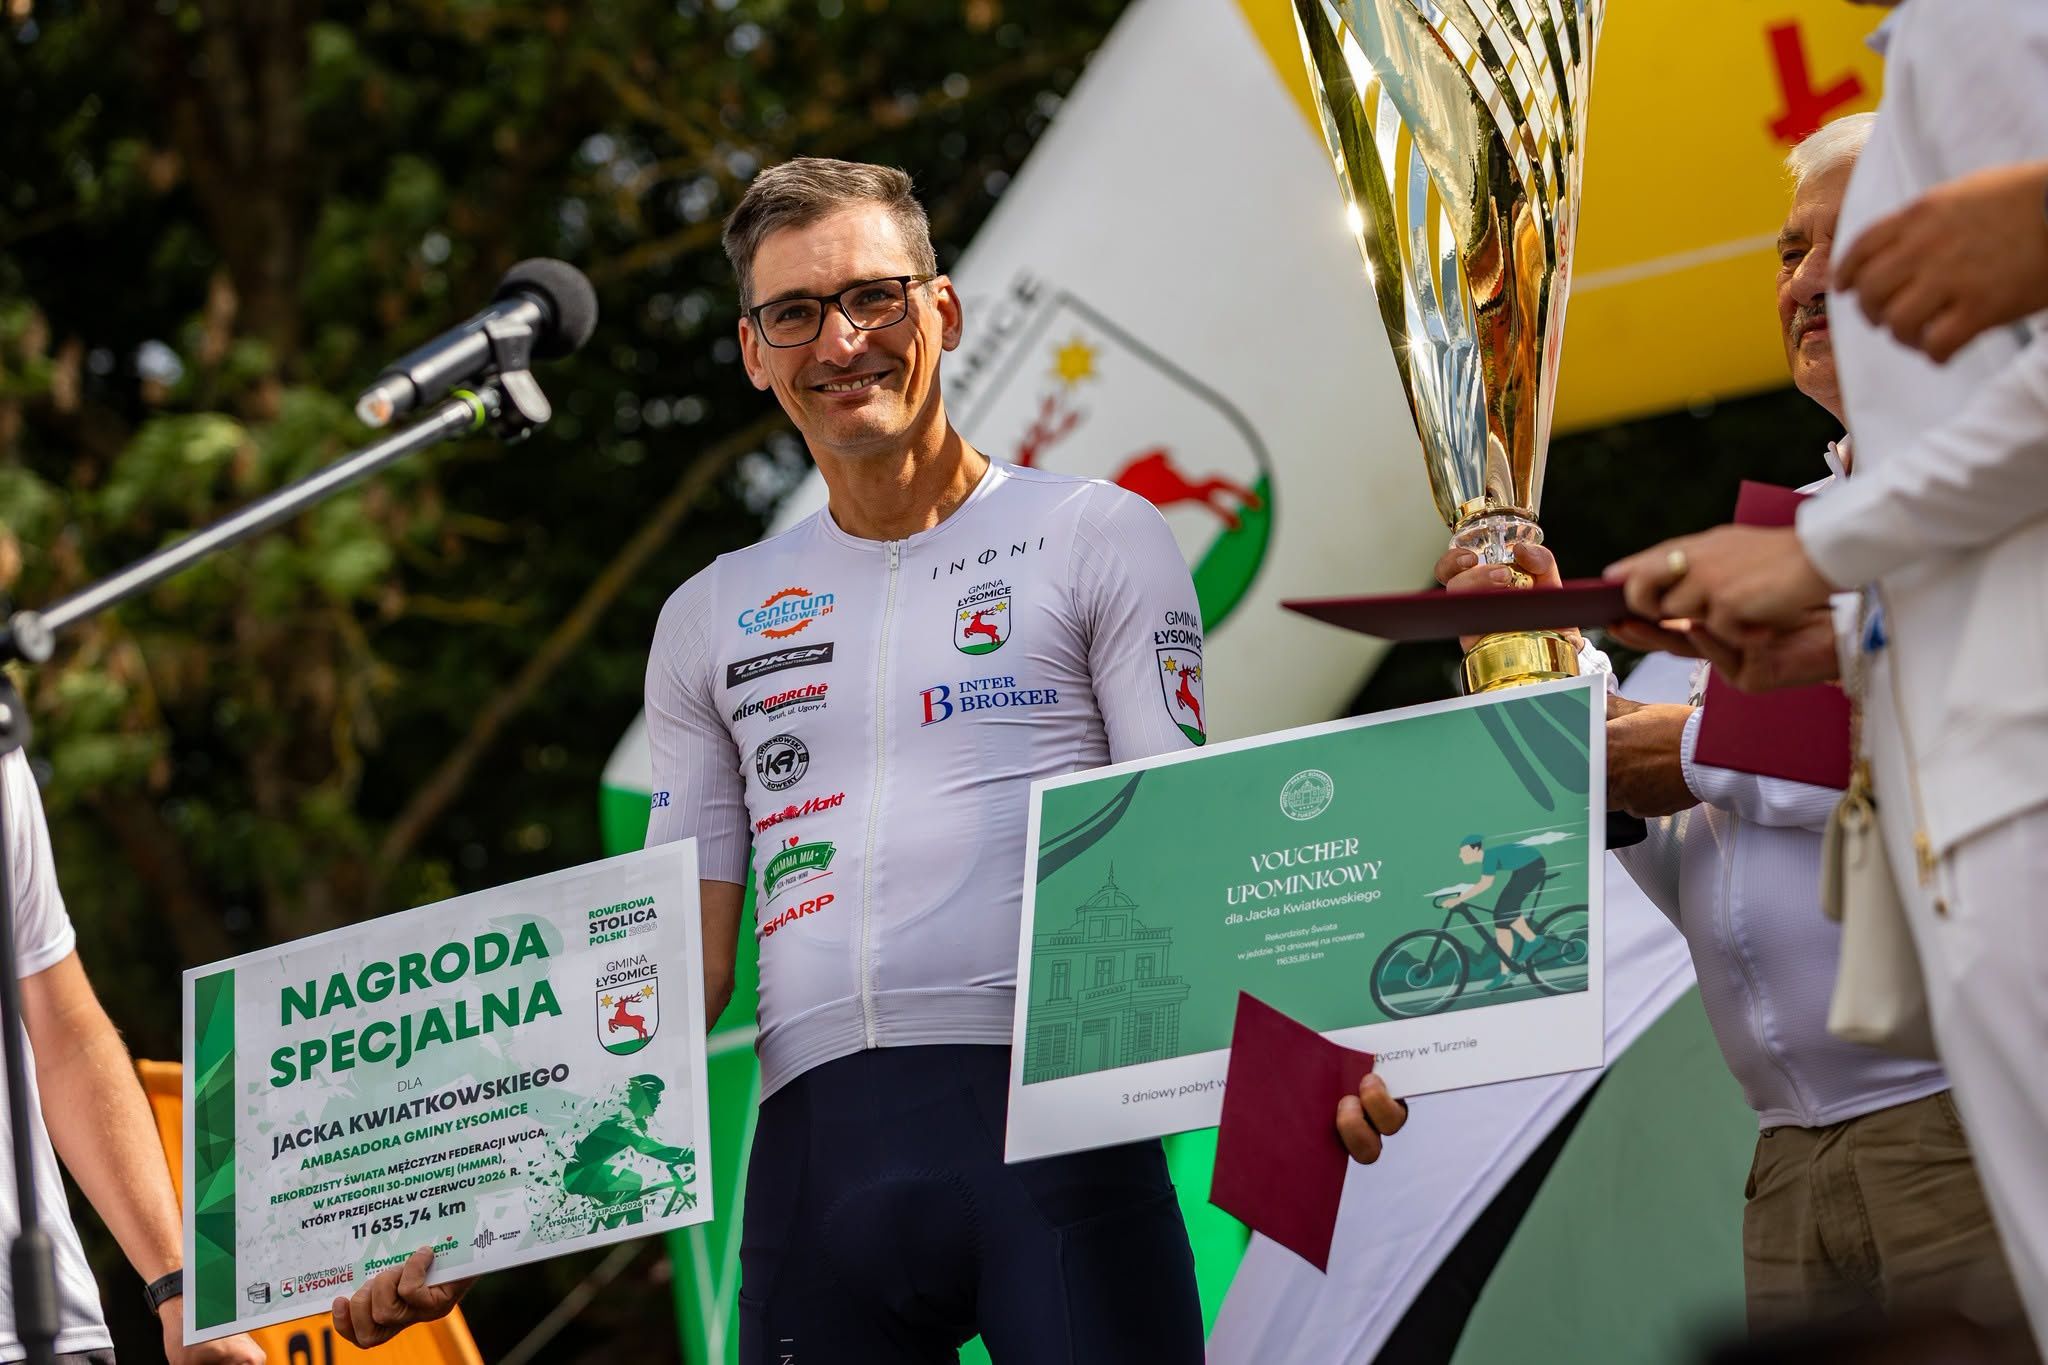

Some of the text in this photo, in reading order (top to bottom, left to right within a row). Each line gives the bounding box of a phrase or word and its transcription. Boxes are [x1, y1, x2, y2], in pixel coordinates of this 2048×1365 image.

[958, 586, 1012, 607] ŁYSOMICE
[968, 579, 1004, 594] GMINA
[738, 592, 834, 628] Centrum
[745, 606, 834, 636] ROWEROWE.pl
[1165, 610, 1198, 630] GMINA
[734, 646, 829, 676] TOKEN
[959, 676, 1016, 693] INTER
[798, 703, 820, 714] Ugory
[960, 688, 1060, 712] BROKER
[767, 775, 797, 788] ROWERY
[772, 850, 815, 878] MAMMA MIA
[1250, 837, 1359, 872] VOUCHER
[1226, 860, 1382, 905] UPOMINKOWY
[588, 896, 655, 920] ROWEROWA
[763, 894, 834, 937] SHARP
[1224, 890, 1381, 925] dla Jacka Kwiatkowskiego
[589, 908, 658, 934] STOLICA
[1265, 922, 1338, 942] Rekordzisty Świata
[589, 930, 626, 946] POLSKI
[1274, 944, 1286, 954] 30
[1287, 938, 1319, 951] dniowej
[1332, 932, 1365, 943] rowerze
[606, 954, 648, 972] GMINA
[1311, 951, 1324, 960] km
[281, 922, 550, 1026] NAGRODA
[596, 964, 658, 988] ŁYSOMICE
[270, 979, 562, 1088] SPECJALNA
[1121, 1093, 1130, 1104] 3
[1132, 1087, 1177, 1103] dniowy
[1179, 1080, 1214, 1096] pobyt
[1376, 1048, 1416, 1063] tyczny
[1418, 1046, 1430, 1056] w
[1432, 1036, 1478, 1054] Turznie
[397, 1076, 422, 1092] DLA
[272, 1063, 570, 1160] JACKA KWIATKOWSKIEGO
[300, 1102, 528, 1170] AMBASADORA GMINY ŁYSOMICE
[270, 1128, 548, 1205] REKORDZISTY ŚWIATA MĘŻCZYZN FEDERACJI WUCA,
[313, 1152, 506, 1210] W KATEGORII 30-DNIOWEJ (HMMR),
[301, 1167, 521, 1230] KTÓRY PRZEJECHAŁ W CZERWCU 2026 R.
[598, 1204, 622, 1216] LIPCA
[622, 1202, 642, 1210] 2026
[352, 1200, 466, 1240] 11 635,74 km
[298, 1263, 352, 1284] ROWEROWE
[298, 1272, 354, 1294] ŁYSOMICE
